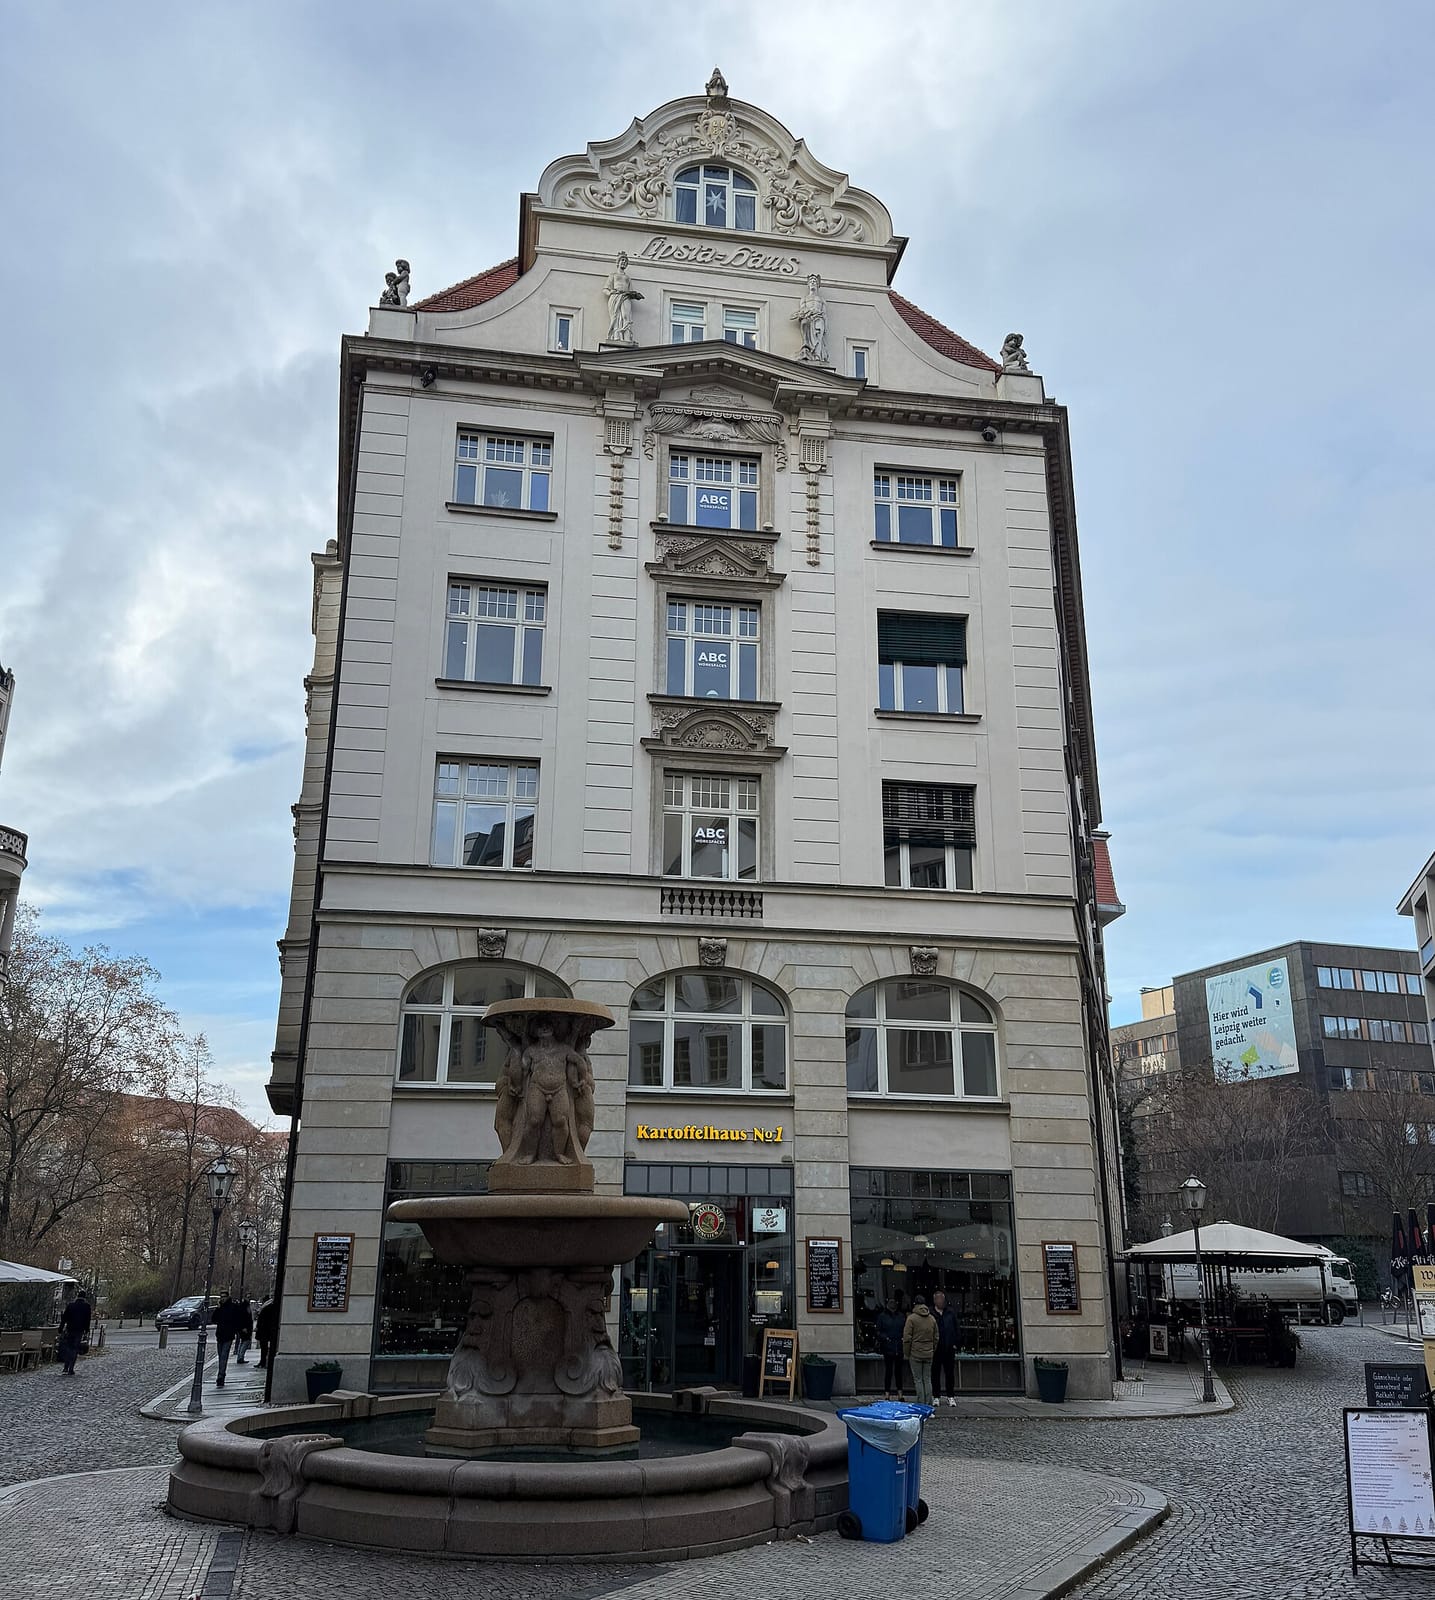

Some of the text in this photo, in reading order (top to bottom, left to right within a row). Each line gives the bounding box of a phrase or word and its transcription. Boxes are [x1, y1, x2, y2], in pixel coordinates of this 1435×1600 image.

[700, 494, 728, 505] ABC
[698, 652, 727, 663] ABC
[695, 827, 725, 839] ABC
[1212, 1006, 1249, 1022] Hier wird
[1213, 1016, 1267, 1036] Leipzig weiter
[1215, 1033, 1247, 1050] gedacht.
[636, 1124, 748, 1141] Kartoffelhaus
